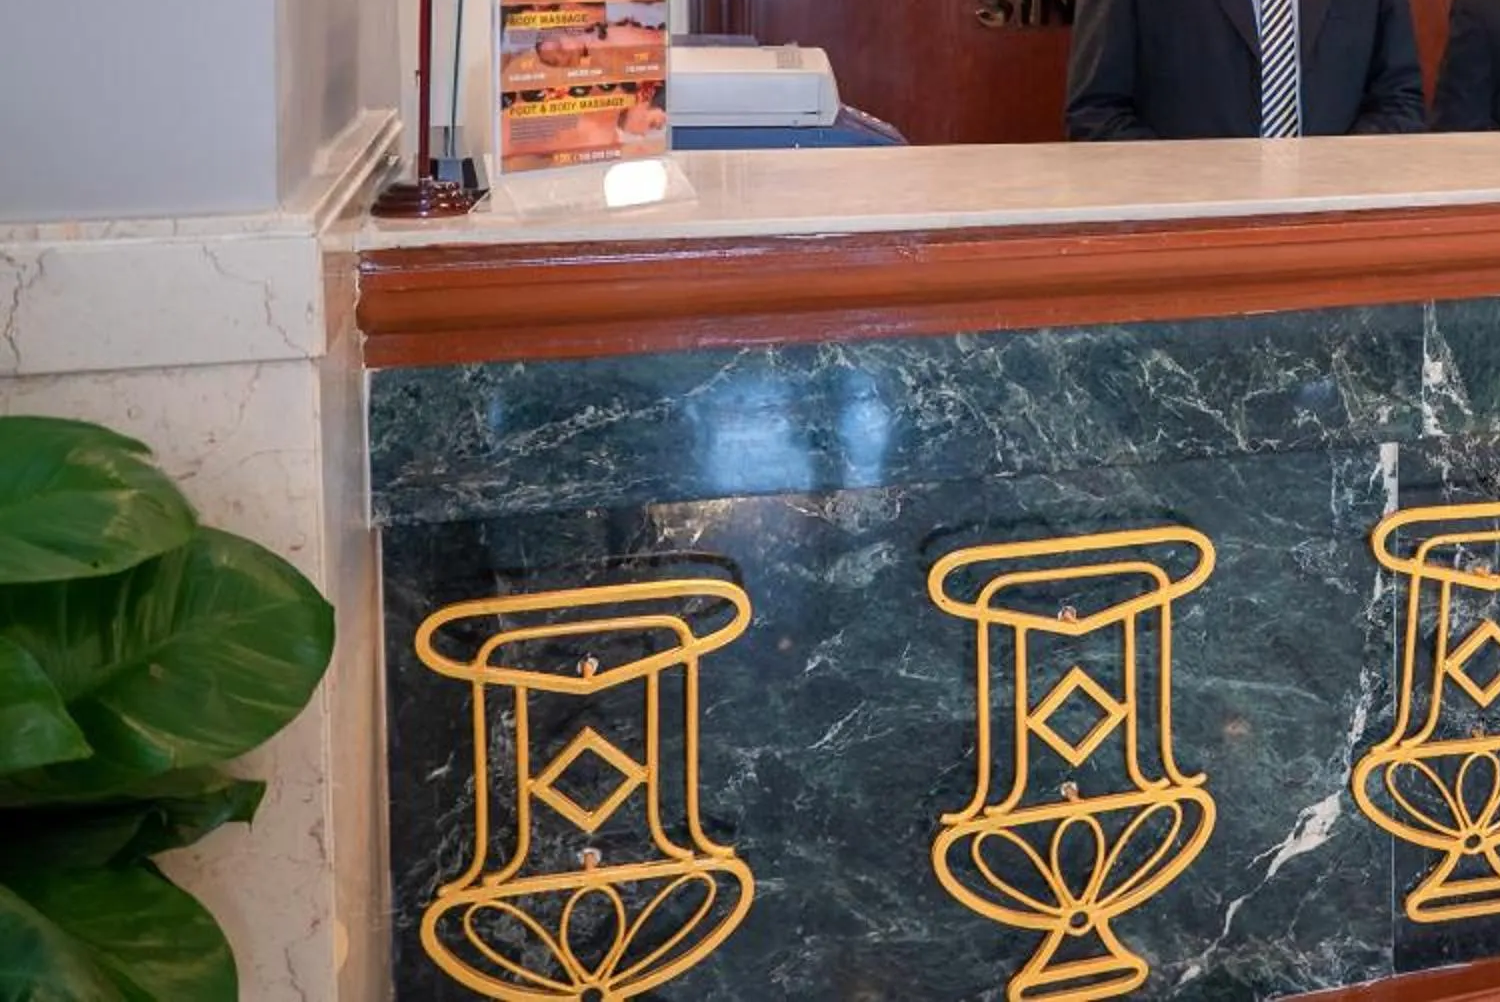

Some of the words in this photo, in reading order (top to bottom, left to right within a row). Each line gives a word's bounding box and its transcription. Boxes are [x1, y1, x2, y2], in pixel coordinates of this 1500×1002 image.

[509, 15, 536, 26] BODY
[539, 13, 588, 24] MASSAGE
[509, 105, 537, 117] FOOT
[550, 102, 577, 113] BODY
[580, 98, 625, 109] MASSAGE
